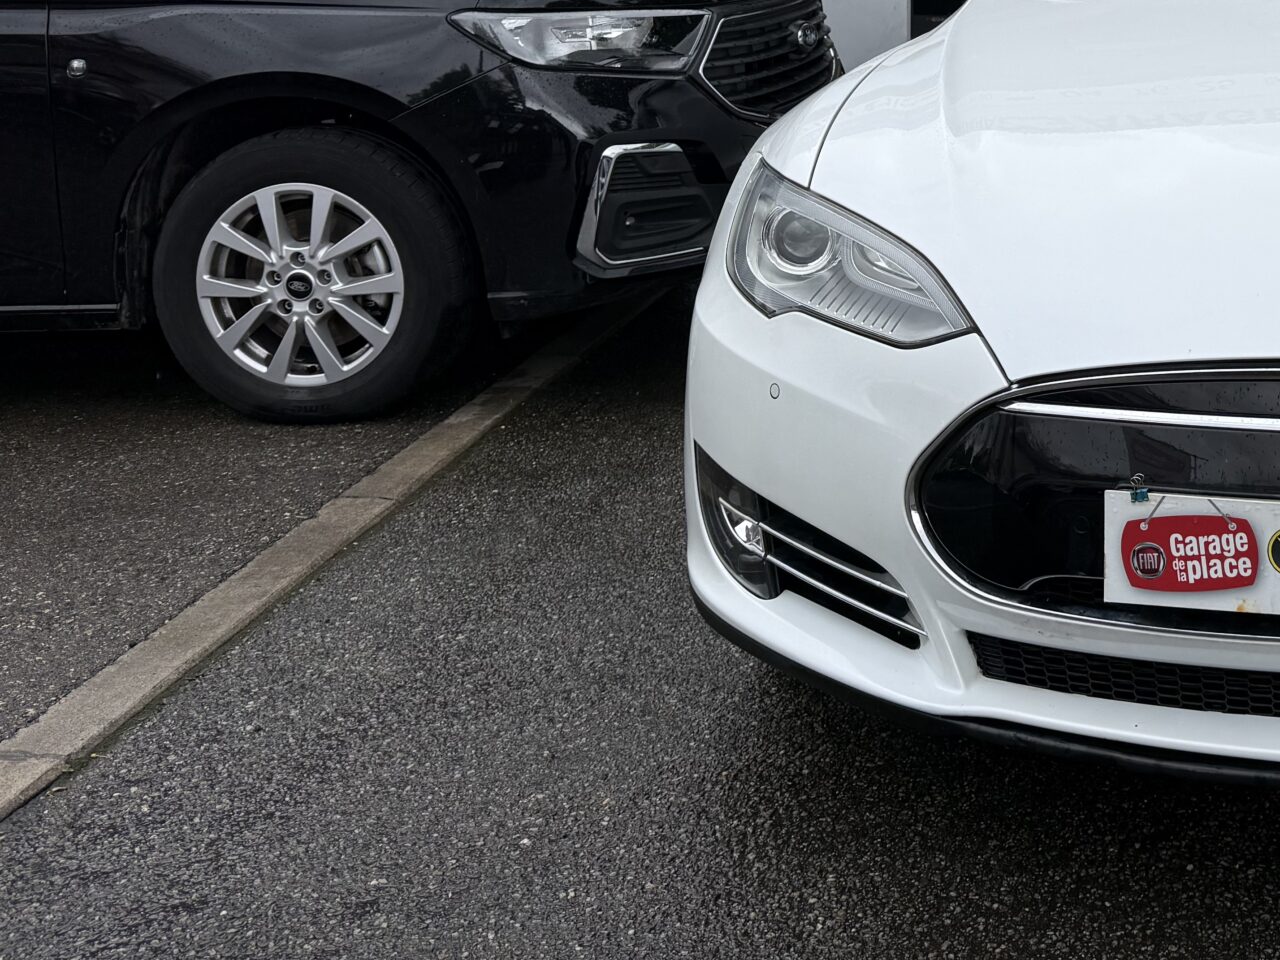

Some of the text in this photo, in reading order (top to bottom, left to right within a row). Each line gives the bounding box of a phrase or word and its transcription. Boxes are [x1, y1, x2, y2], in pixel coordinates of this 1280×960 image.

[1169, 532, 1249, 557] Garage
[1138, 552, 1159, 569] FIAT
[1172, 558, 1185, 571] de
[1177, 569, 1187, 582] la
[1186, 556, 1252, 584] place
